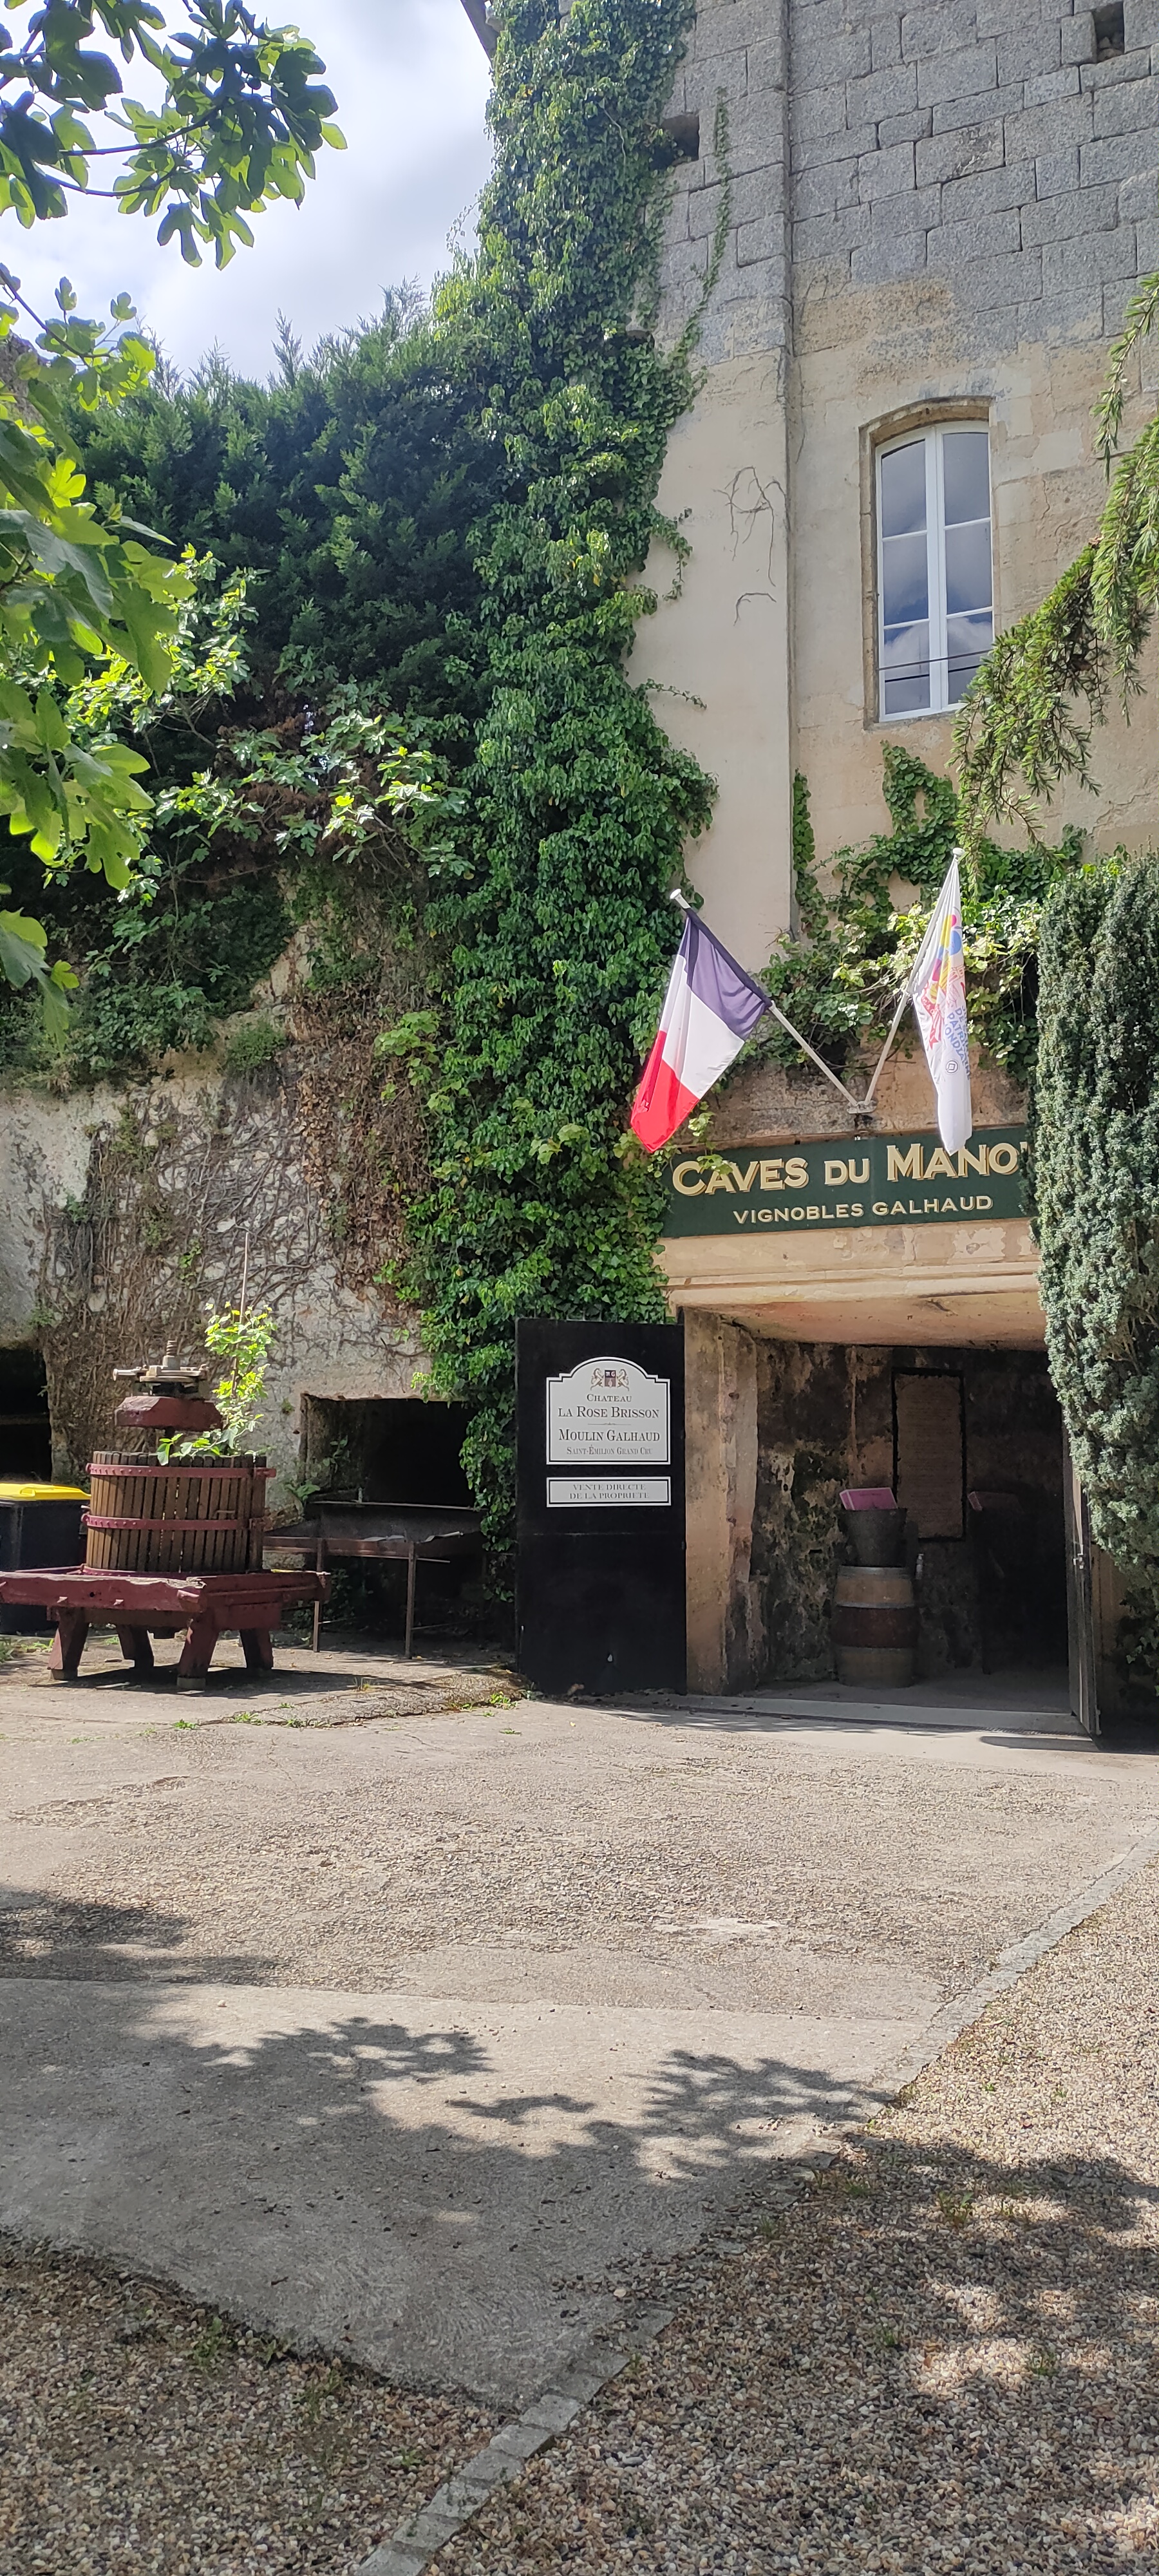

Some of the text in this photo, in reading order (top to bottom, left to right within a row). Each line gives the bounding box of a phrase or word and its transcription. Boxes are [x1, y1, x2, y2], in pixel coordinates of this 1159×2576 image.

[945, 1024, 965, 1066] ONDIAL
[672, 1141, 1029, 1197] CAVES DU MANO
[733, 1195, 994, 1224] VIGNOBLES GALHAUD
[587, 1393, 632, 1403] CHATEAU
[558, 1406, 660, 1419] LA ROSE BRISSON
[558, 1428, 661, 1442] MOULIN GALHAUD
[567, 1444, 654, 1455] SAINT-ÉMILION GRAND CRU
